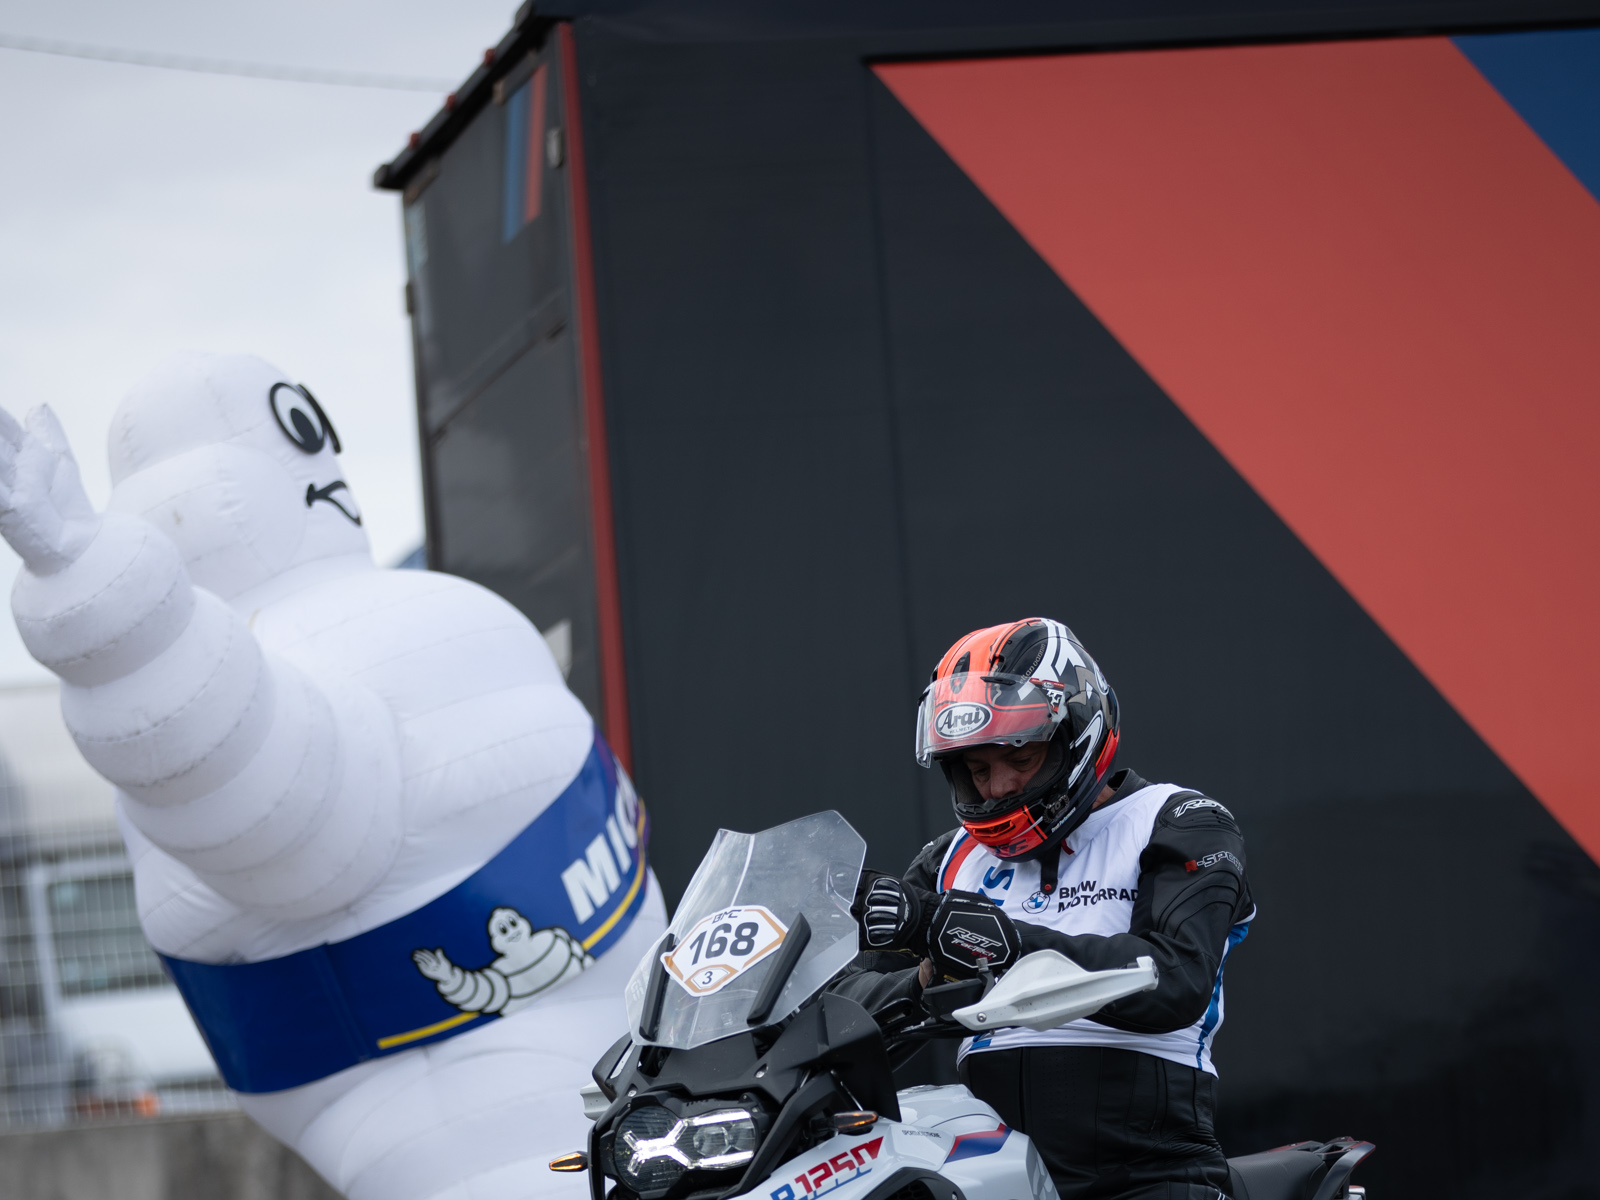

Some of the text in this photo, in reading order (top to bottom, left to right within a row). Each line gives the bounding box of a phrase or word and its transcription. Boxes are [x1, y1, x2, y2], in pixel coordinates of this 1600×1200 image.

[938, 706, 982, 732] Arai
[1172, 799, 1235, 820] RST
[1057, 888, 1139, 913] MOTORRAD
[1059, 880, 1097, 899] BMW
[689, 922, 759, 966] 168
[947, 926, 1003, 948] RST
[702, 970, 714, 985] 3
